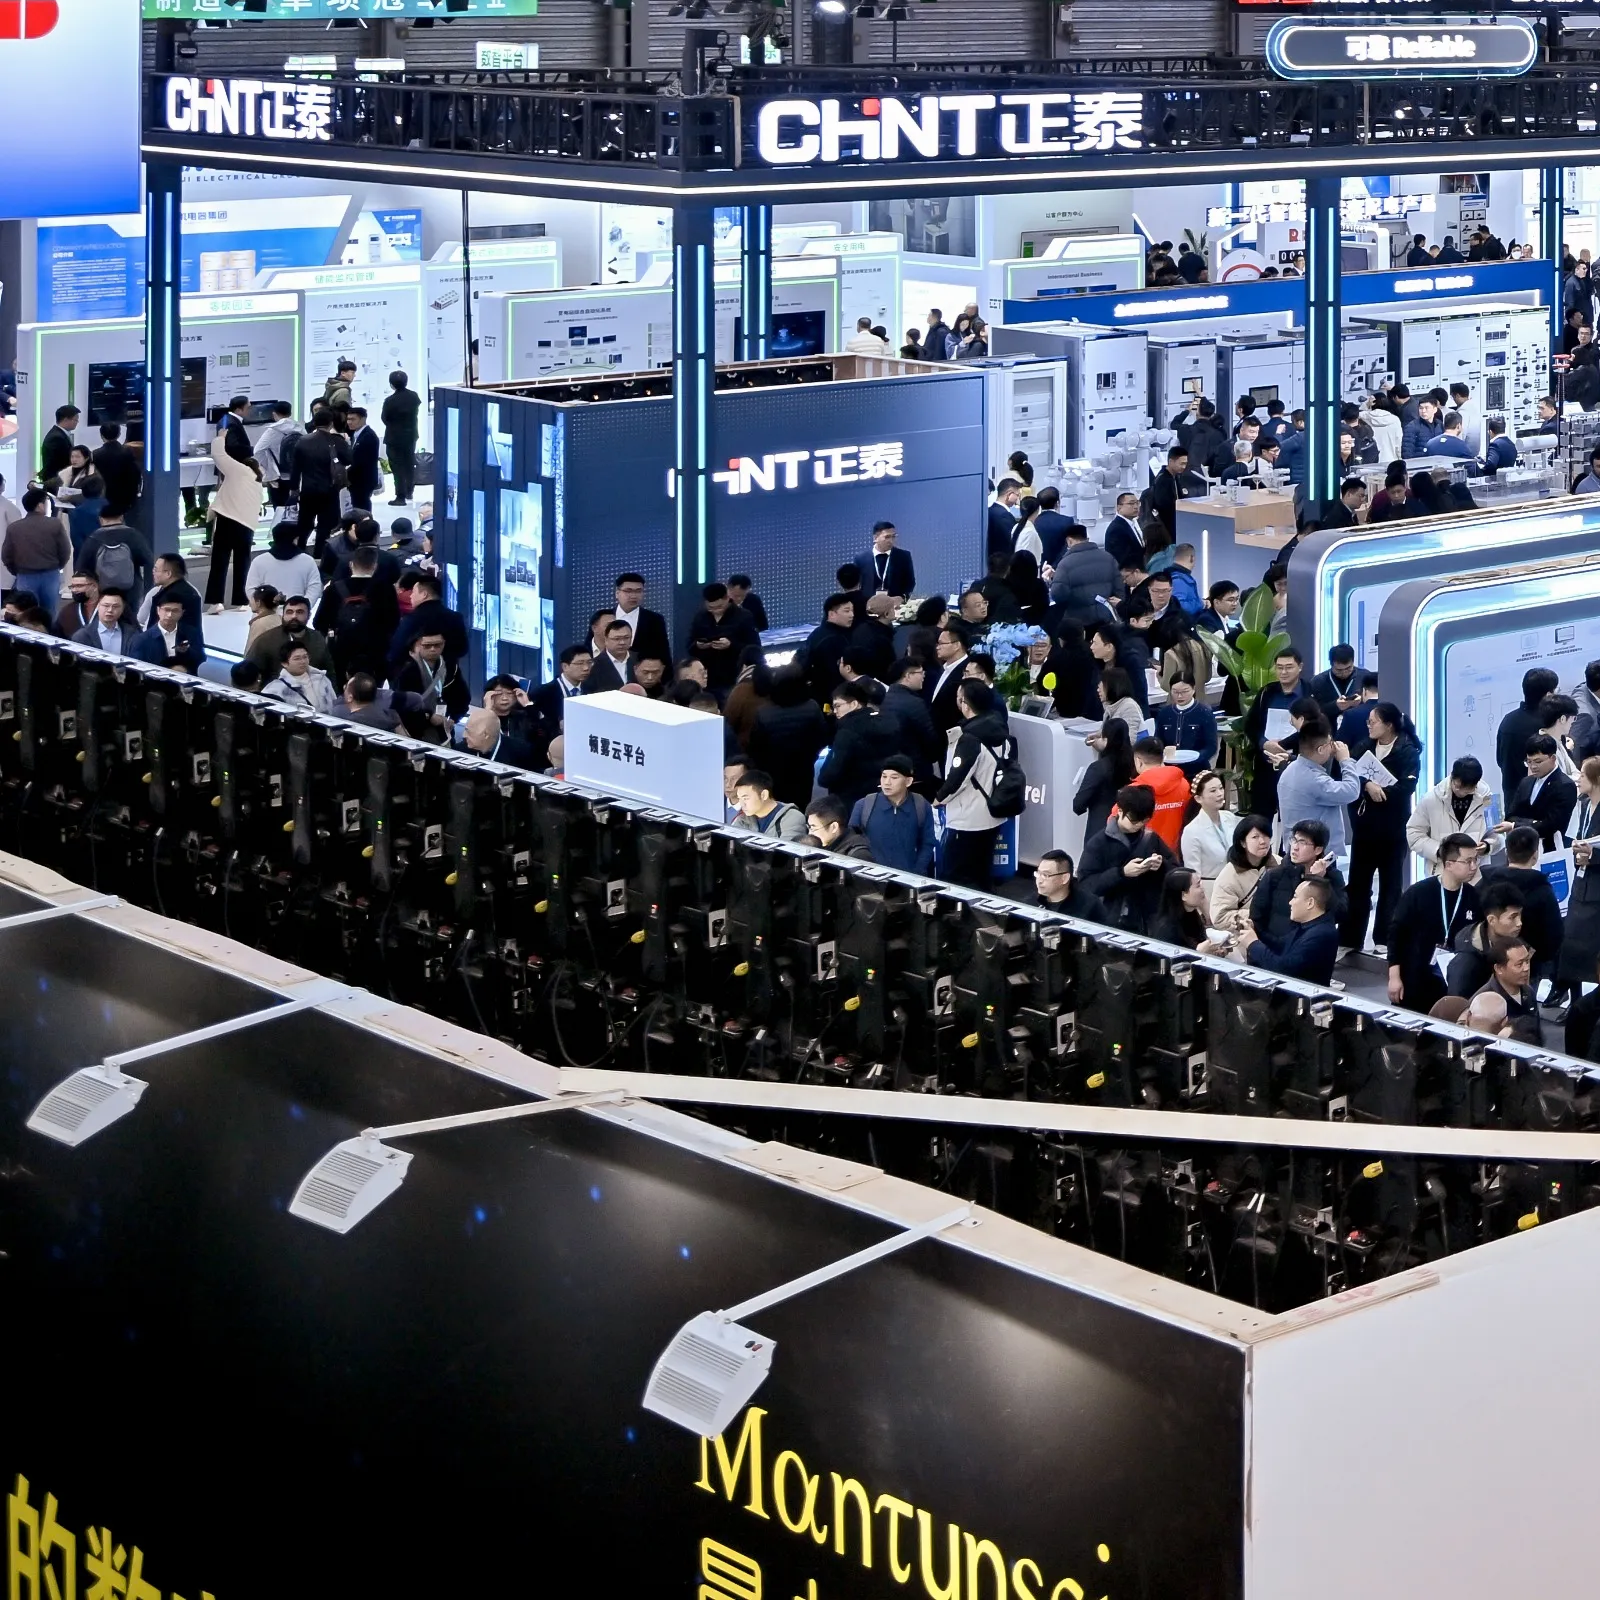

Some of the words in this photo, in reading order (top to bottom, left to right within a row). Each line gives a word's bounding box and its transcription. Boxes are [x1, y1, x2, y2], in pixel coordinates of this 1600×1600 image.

[262, 83, 335, 141] 正泰
[1000, 92, 1143, 155] 正泰
[196, 174, 267, 183] ELECTRICAL
[814, 441, 904, 485] 正泰
